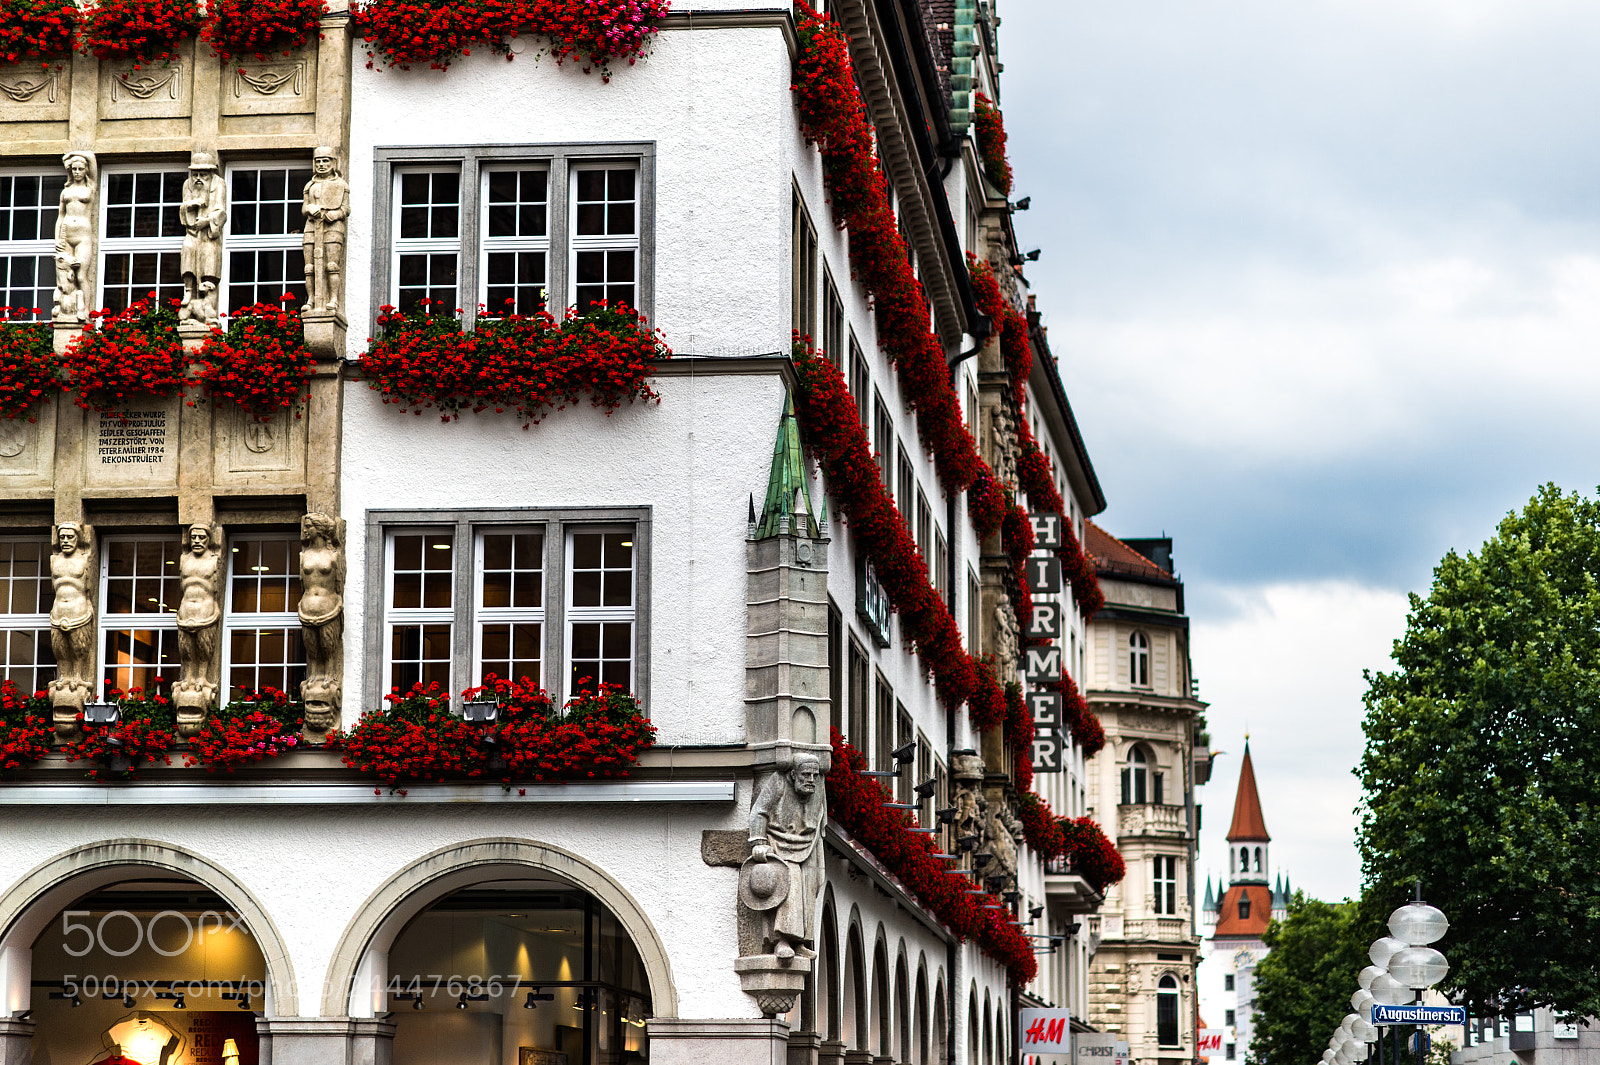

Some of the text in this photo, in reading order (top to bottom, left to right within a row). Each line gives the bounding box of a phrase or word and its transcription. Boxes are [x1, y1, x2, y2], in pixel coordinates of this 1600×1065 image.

[112, 420, 127, 428] VON
[126, 428, 166, 436] GESCHAFFEN
[149, 437, 165, 445] VON
[98, 447, 118, 455] PETER
[102, 454, 163, 464] REKONSTRUIERT
[1027, 516, 1060, 768] HIRMER
[1379, 1006, 1461, 1021] Augustinerstr.
[1026, 1018, 1066, 1044] H&M
[1079, 1046, 1114, 1056] CHRIST
